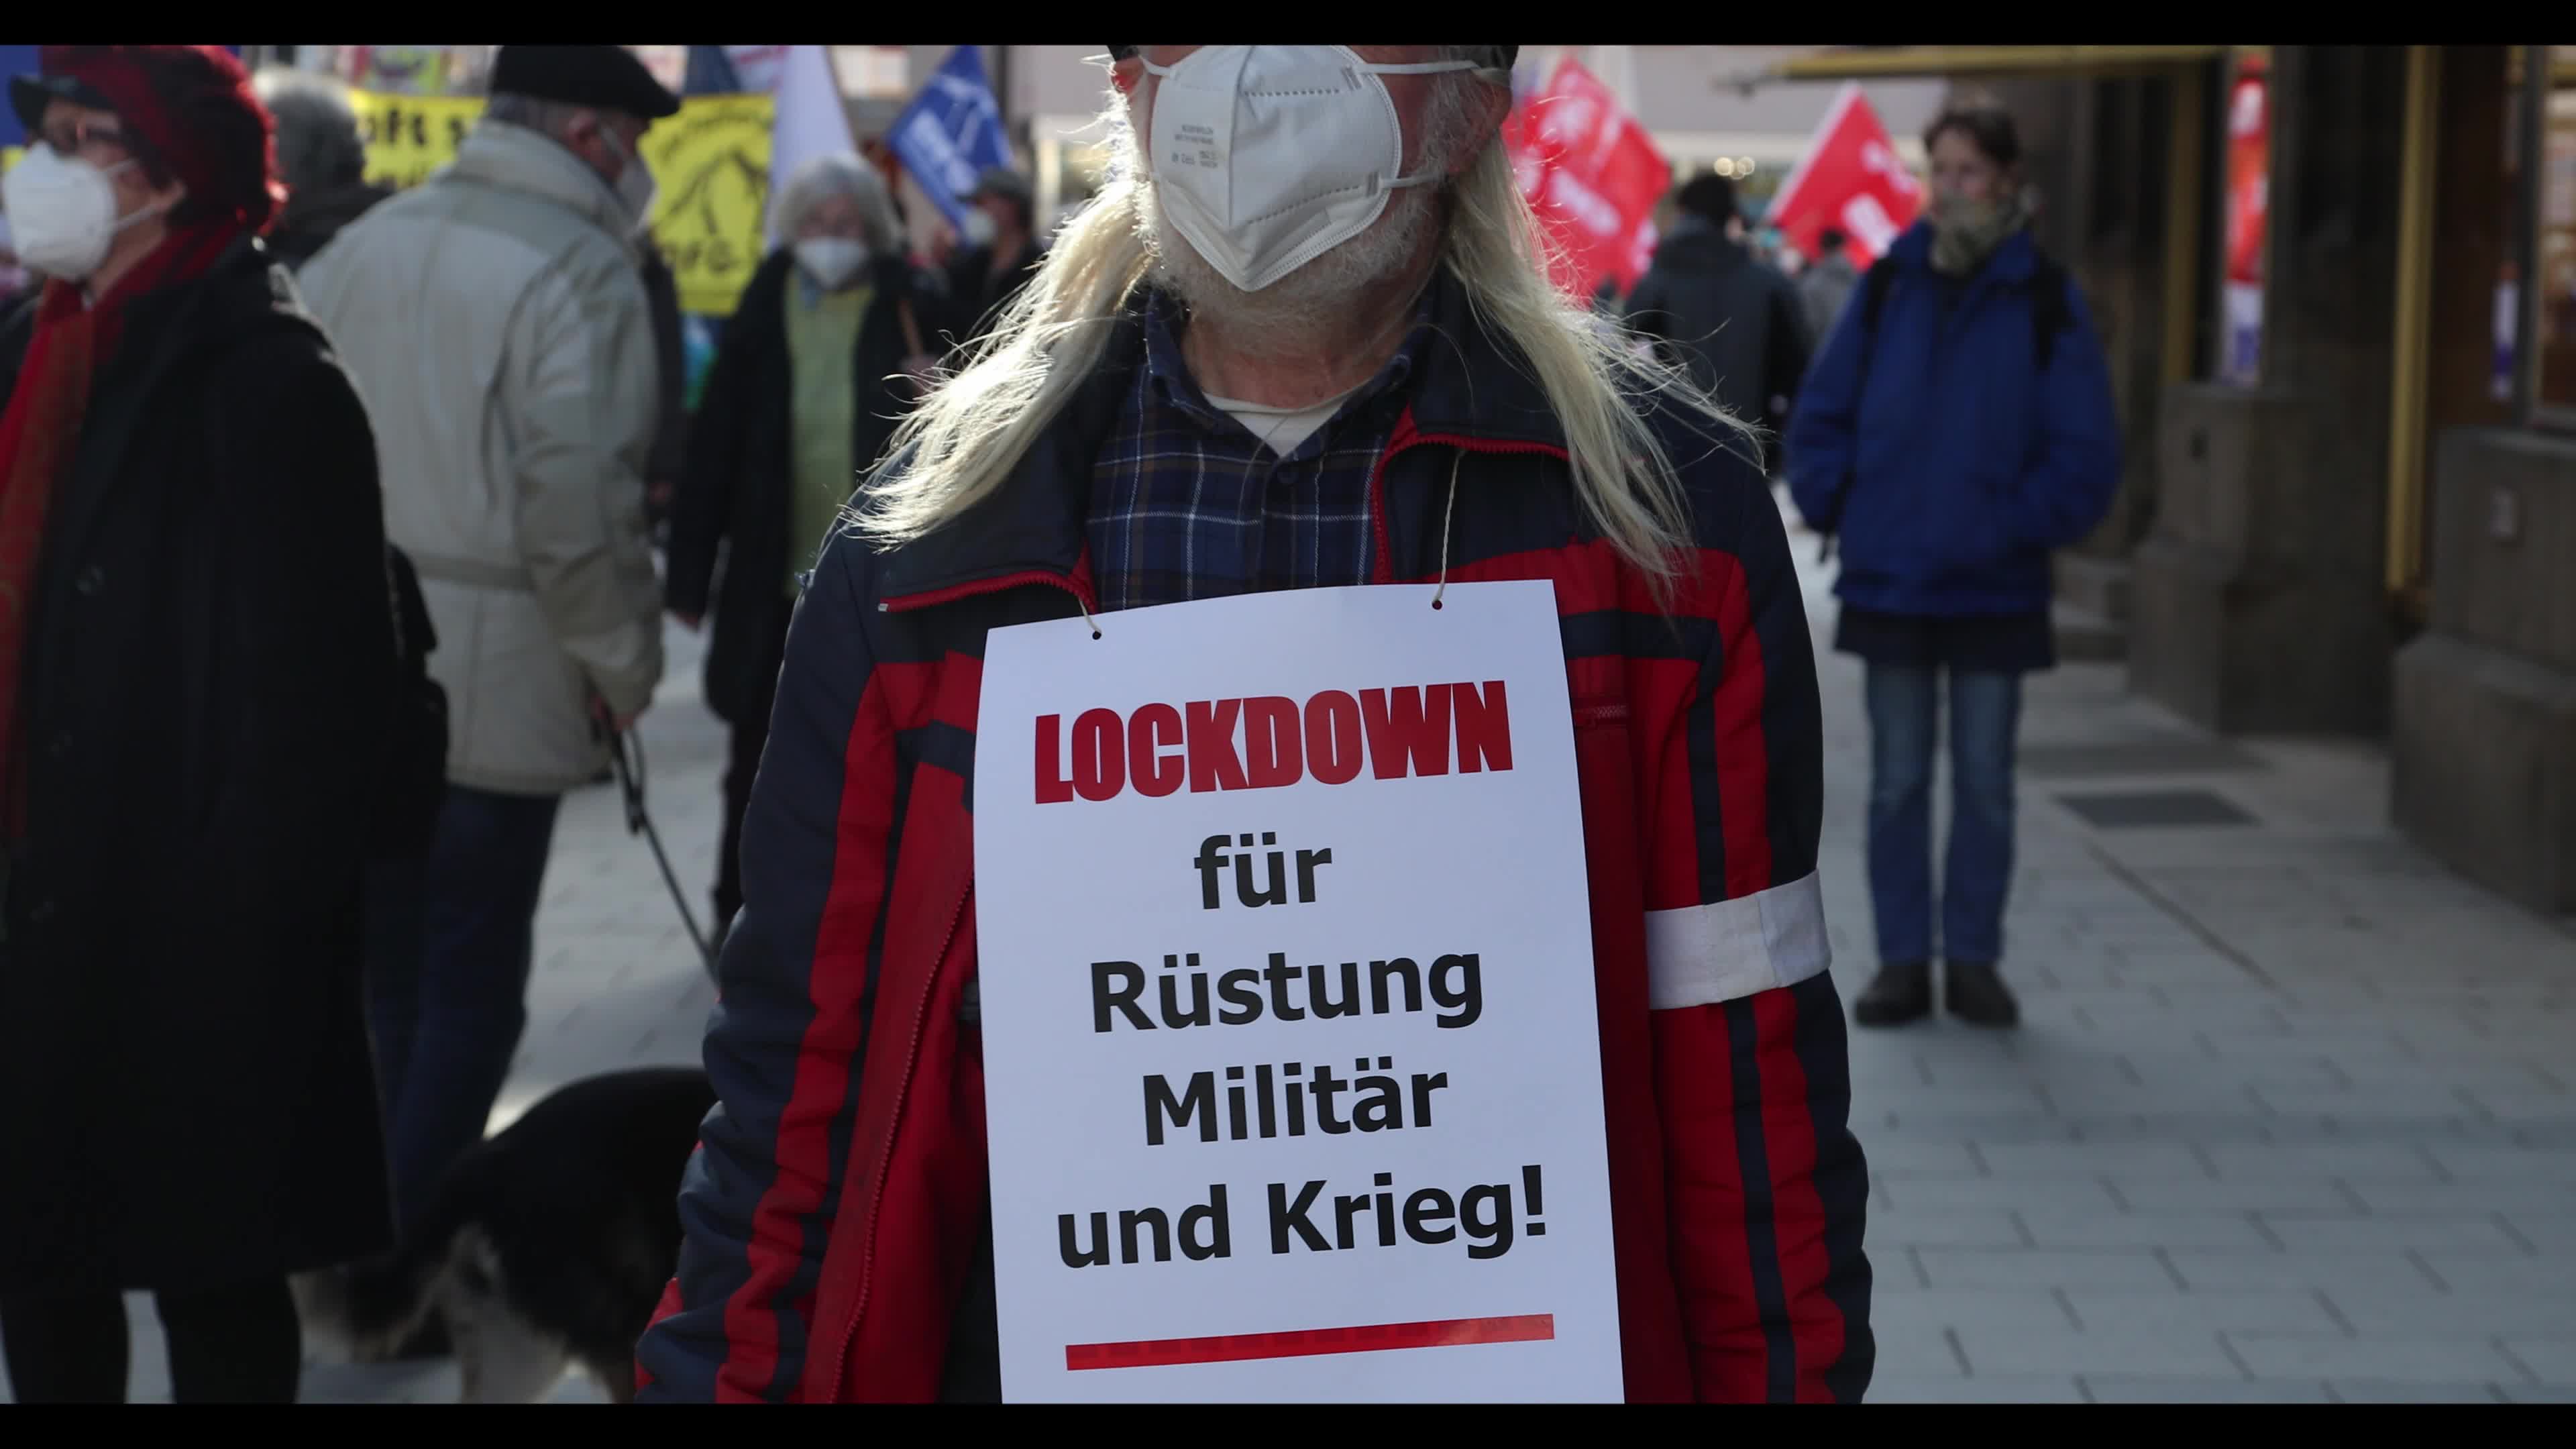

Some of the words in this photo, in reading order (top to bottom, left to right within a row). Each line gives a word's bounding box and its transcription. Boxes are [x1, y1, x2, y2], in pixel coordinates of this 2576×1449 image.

[1035, 680, 1513, 804] LOCKDOWN
[1194, 832, 1332, 909] für
[1091, 953, 1482, 1032] Rüstung
[1143, 1057, 1448, 1145] Militär
[1059, 1184, 1230, 1268] und
[1268, 1165, 1546, 1259] Krieg!
